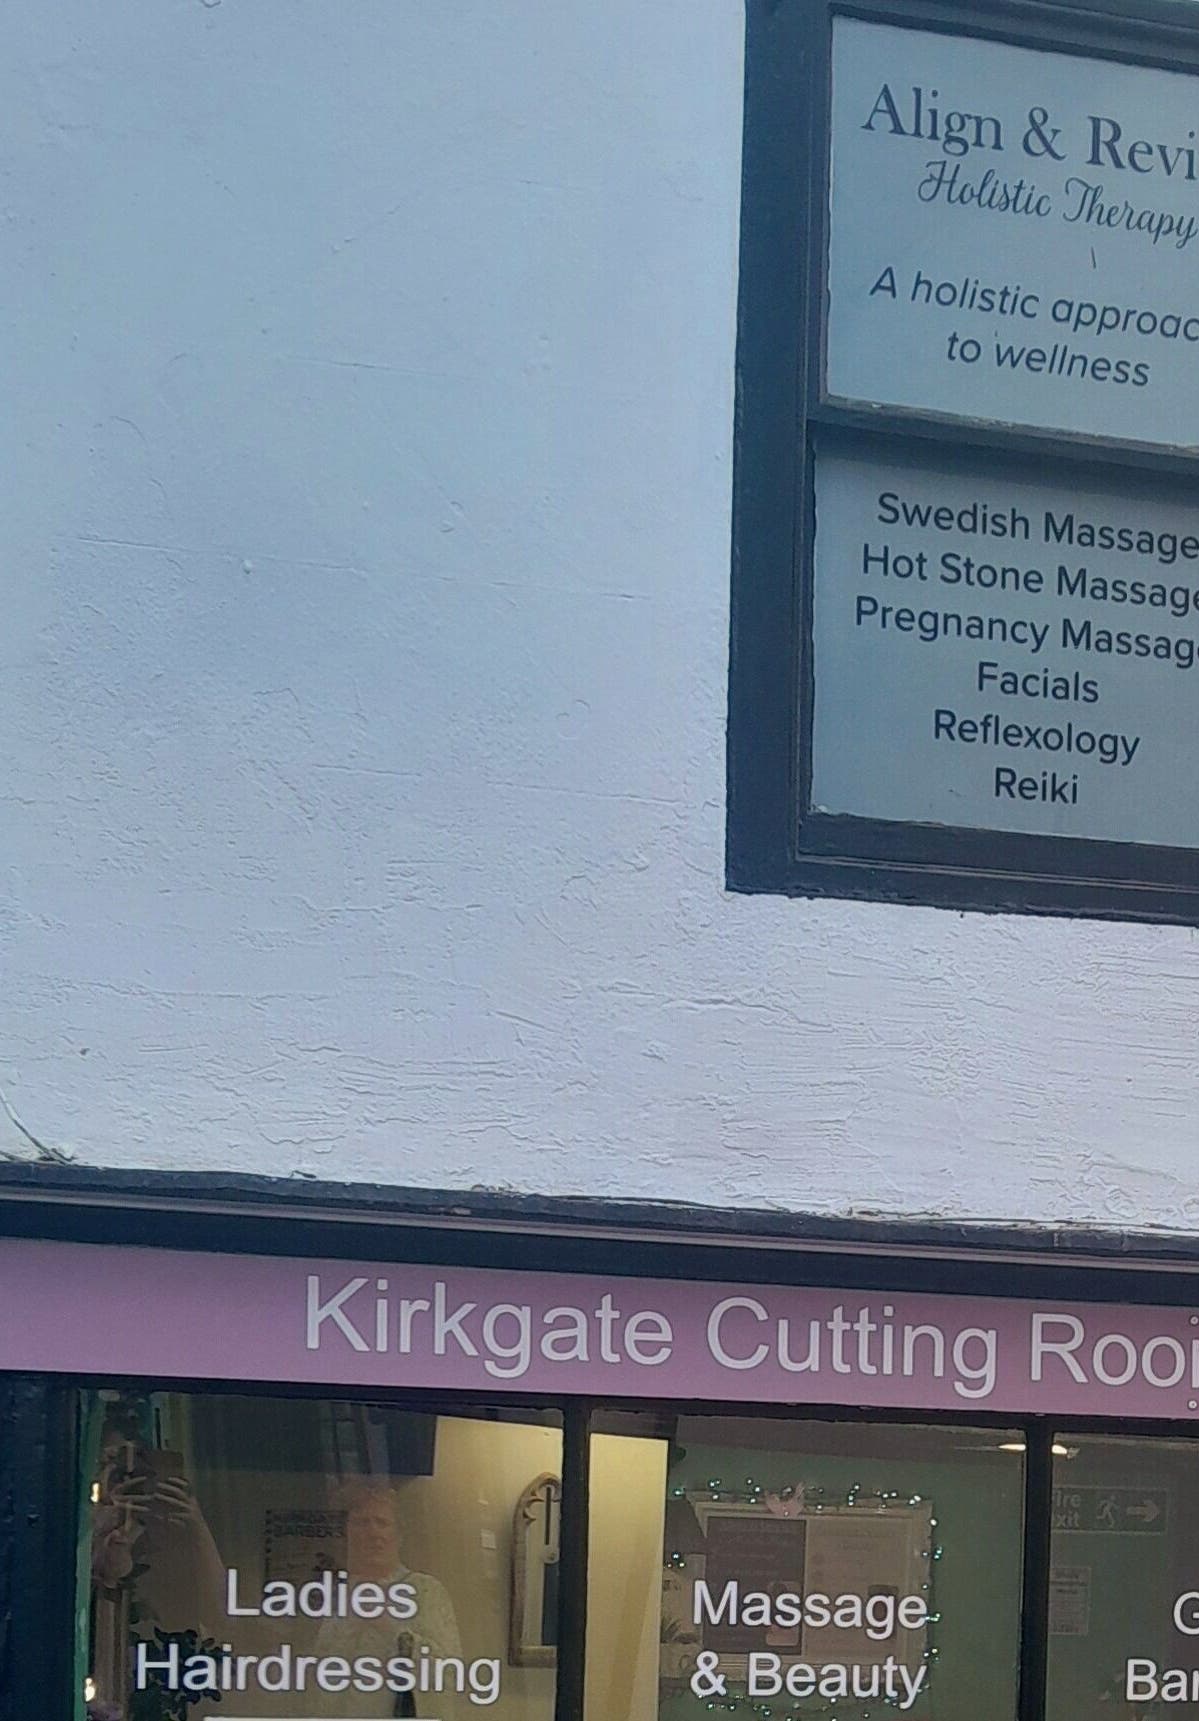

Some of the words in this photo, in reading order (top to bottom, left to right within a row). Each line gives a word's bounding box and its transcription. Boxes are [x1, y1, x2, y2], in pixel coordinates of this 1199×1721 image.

[860, 82, 1004, 156] Align
[1022, 106, 1067, 161] &
[918, 160, 1051, 217] Holistic
[1063, 177, 1199, 249] Therapy
[869, 266, 897, 298] A
[911, 271, 1039, 319] holistic
[947, 331, 981, 363] to
[995, 342, 1150, 387] wellness
[878, 492, 1029, 540] Swedish
[862, 544, 928, 581] Hot
[939, 552, 1044, 592] Stone
[856, 596, 1050, 653] Pregnancy
[977, 662, 1099, 703] Facials
[934, 709, 1140, 766] Reflexology
[994, 766, 1079, 805] Reiki
[305, 1275, 674, 1379] Kirkgate
[707, 1296, 998, 1399] Cutting
[1052, 1489, 1082, 1508] ire
[1052, 1509, 1081, 1528] xit
[226, 1568, 418, 1620] Ladies
[693, 1580, 928, 1641] Massage
[135, 1642, 501, 1706] Hairdressing
[690, 1650, 727, 1697] &
[747, 1652, 928, 1710] Beauty
